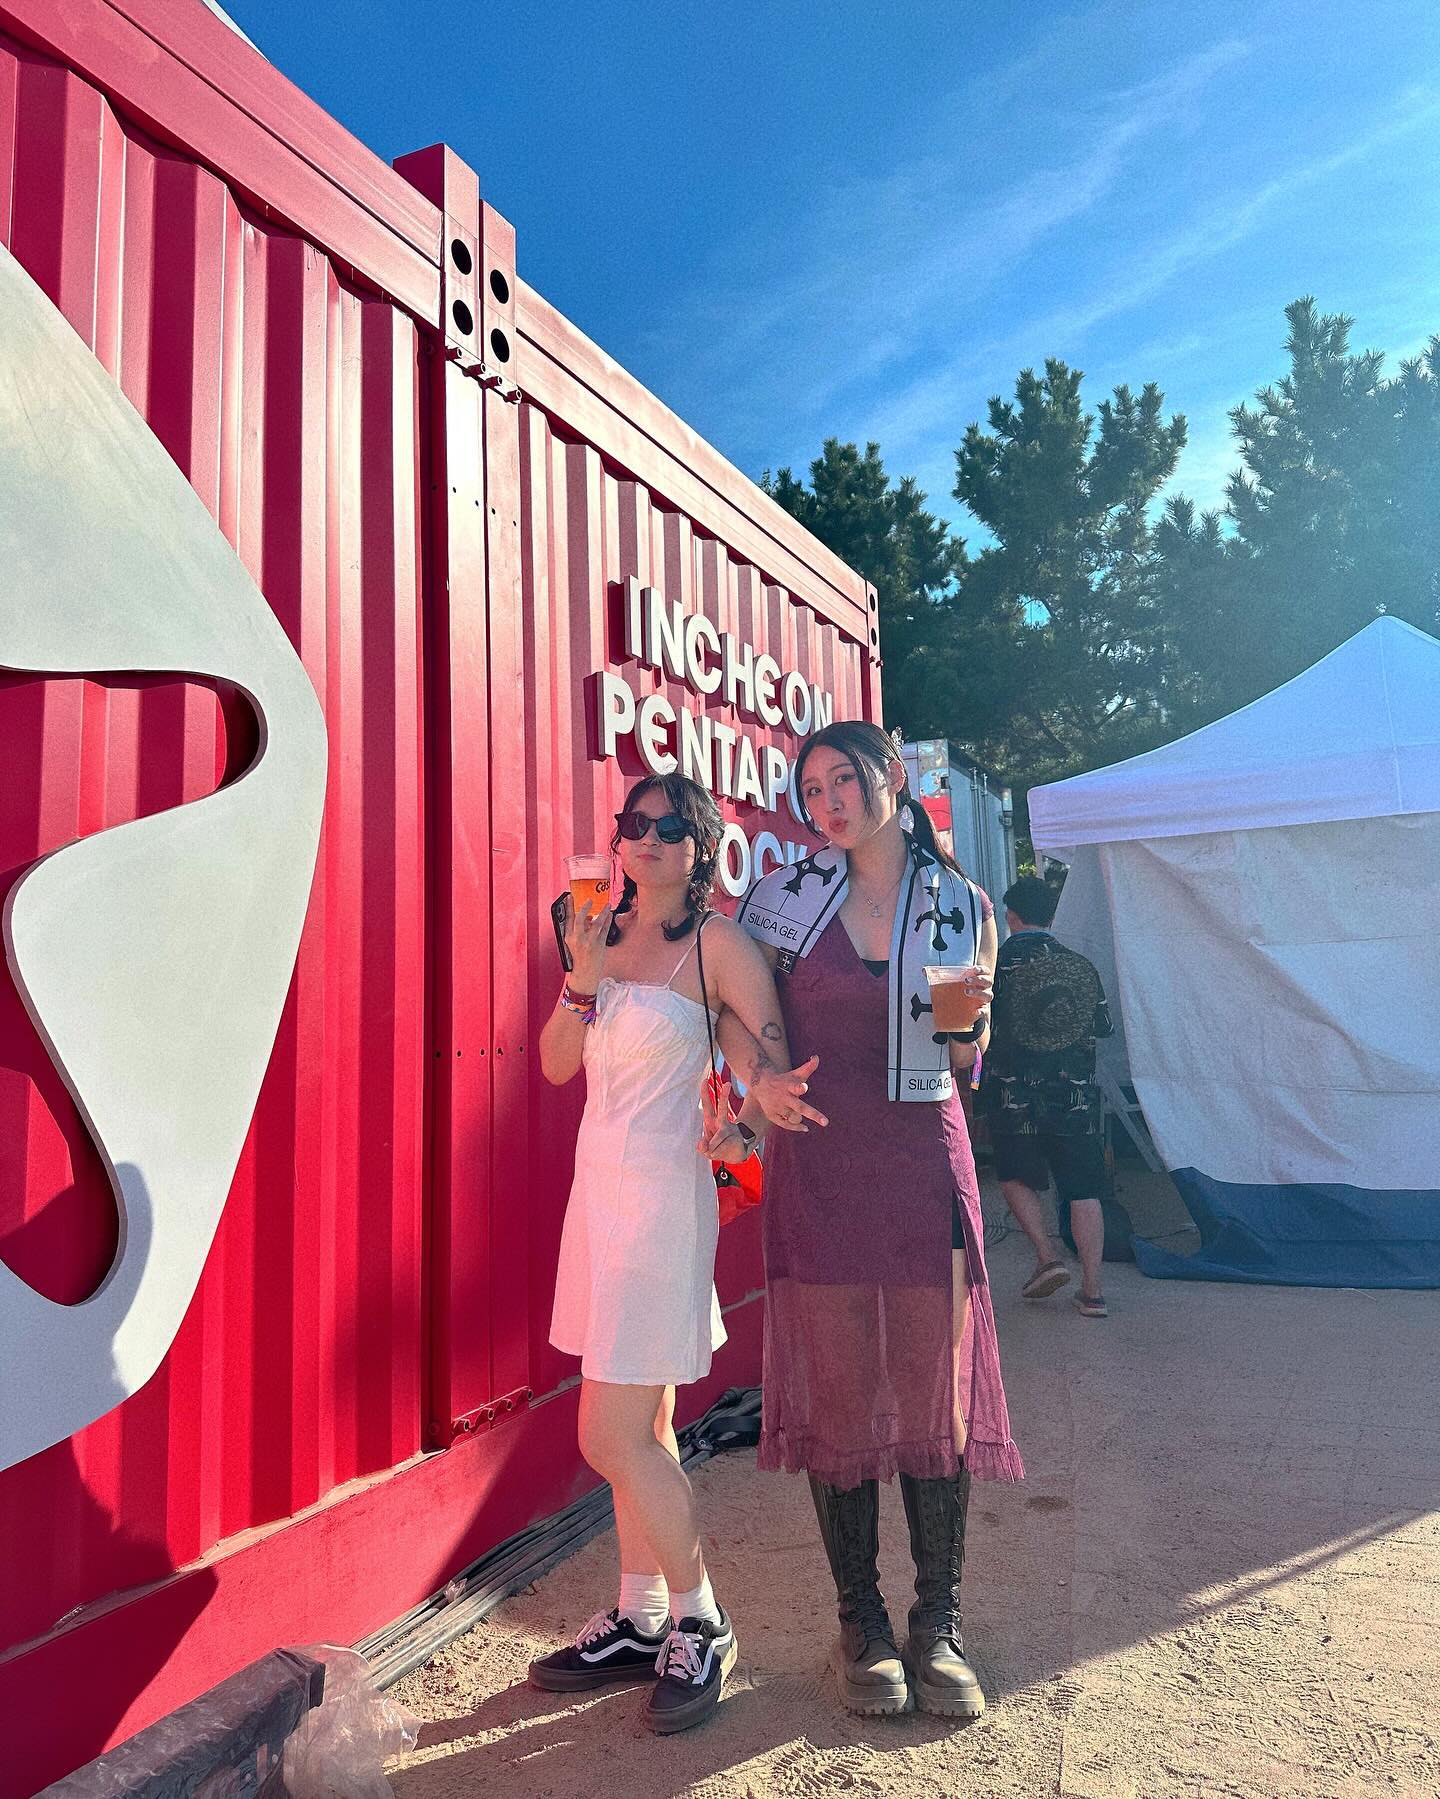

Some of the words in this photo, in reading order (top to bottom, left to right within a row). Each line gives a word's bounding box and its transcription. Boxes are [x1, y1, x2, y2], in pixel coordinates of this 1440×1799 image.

[625, 575, 832, 737] INCHEON
[602, 671, 804, 824] PENTAP
[748, 912, 778, 934] SILICA
[779, 925, 798, 941] GEL
[908, 1078, 943, 1091] SILICA
